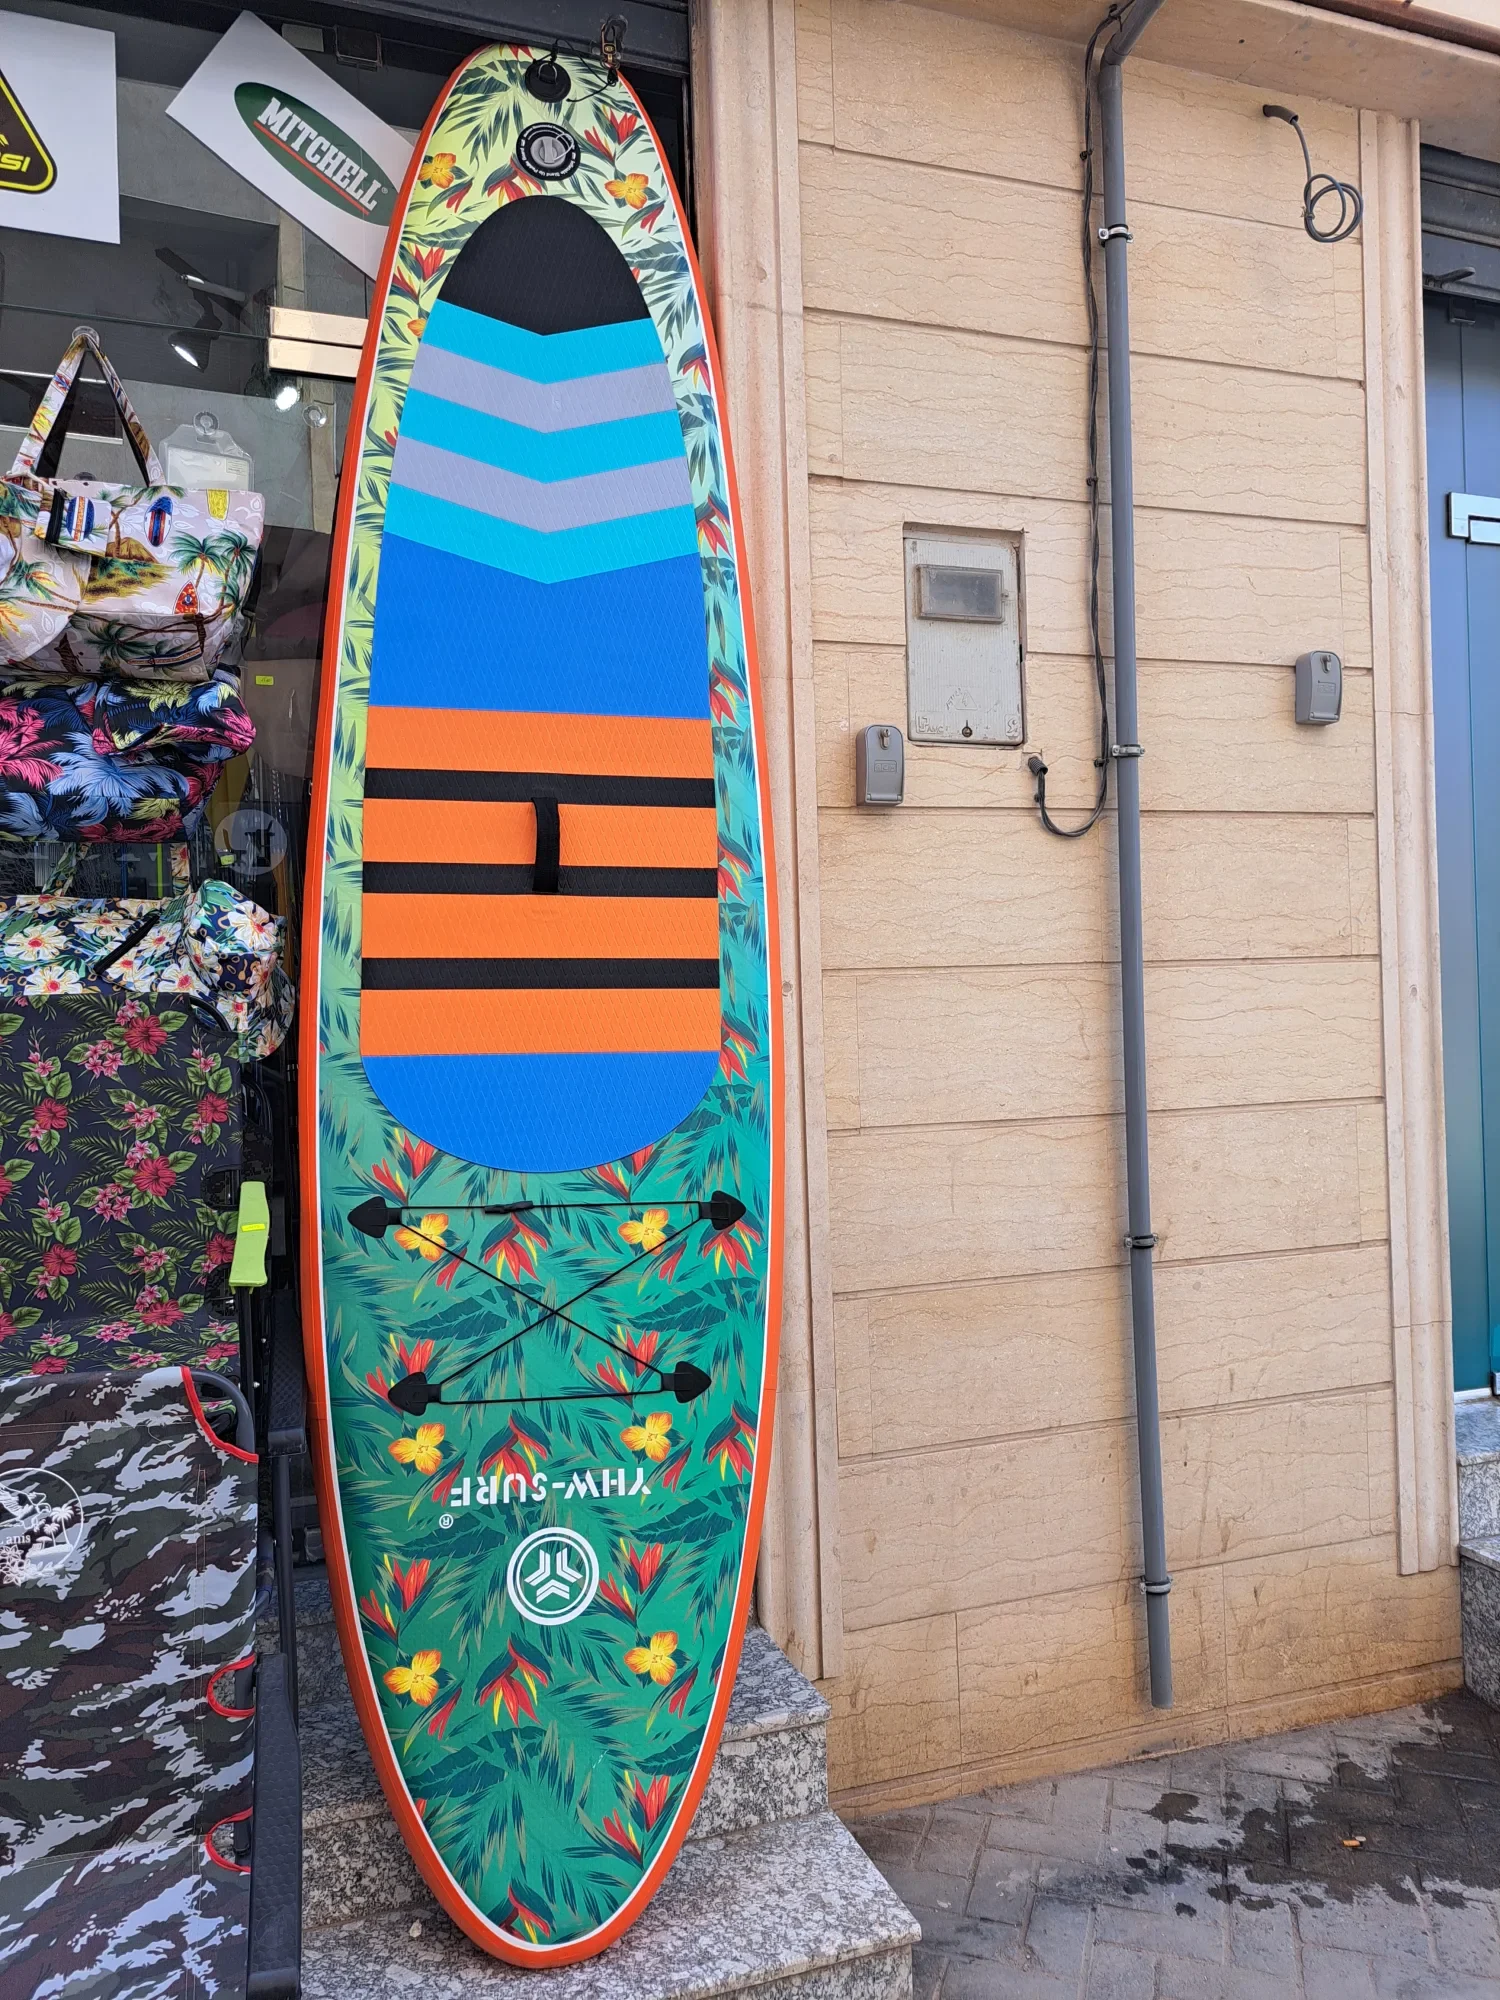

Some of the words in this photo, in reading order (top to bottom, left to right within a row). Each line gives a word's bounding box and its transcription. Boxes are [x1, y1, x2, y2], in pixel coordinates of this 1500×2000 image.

[0, 152, 31, 172] SI
[257, 97, 381, 211] MITCHELL
[451, 1468, 651, 1507] YHW-SURF
[0, 1533, 31, 1544] anis
